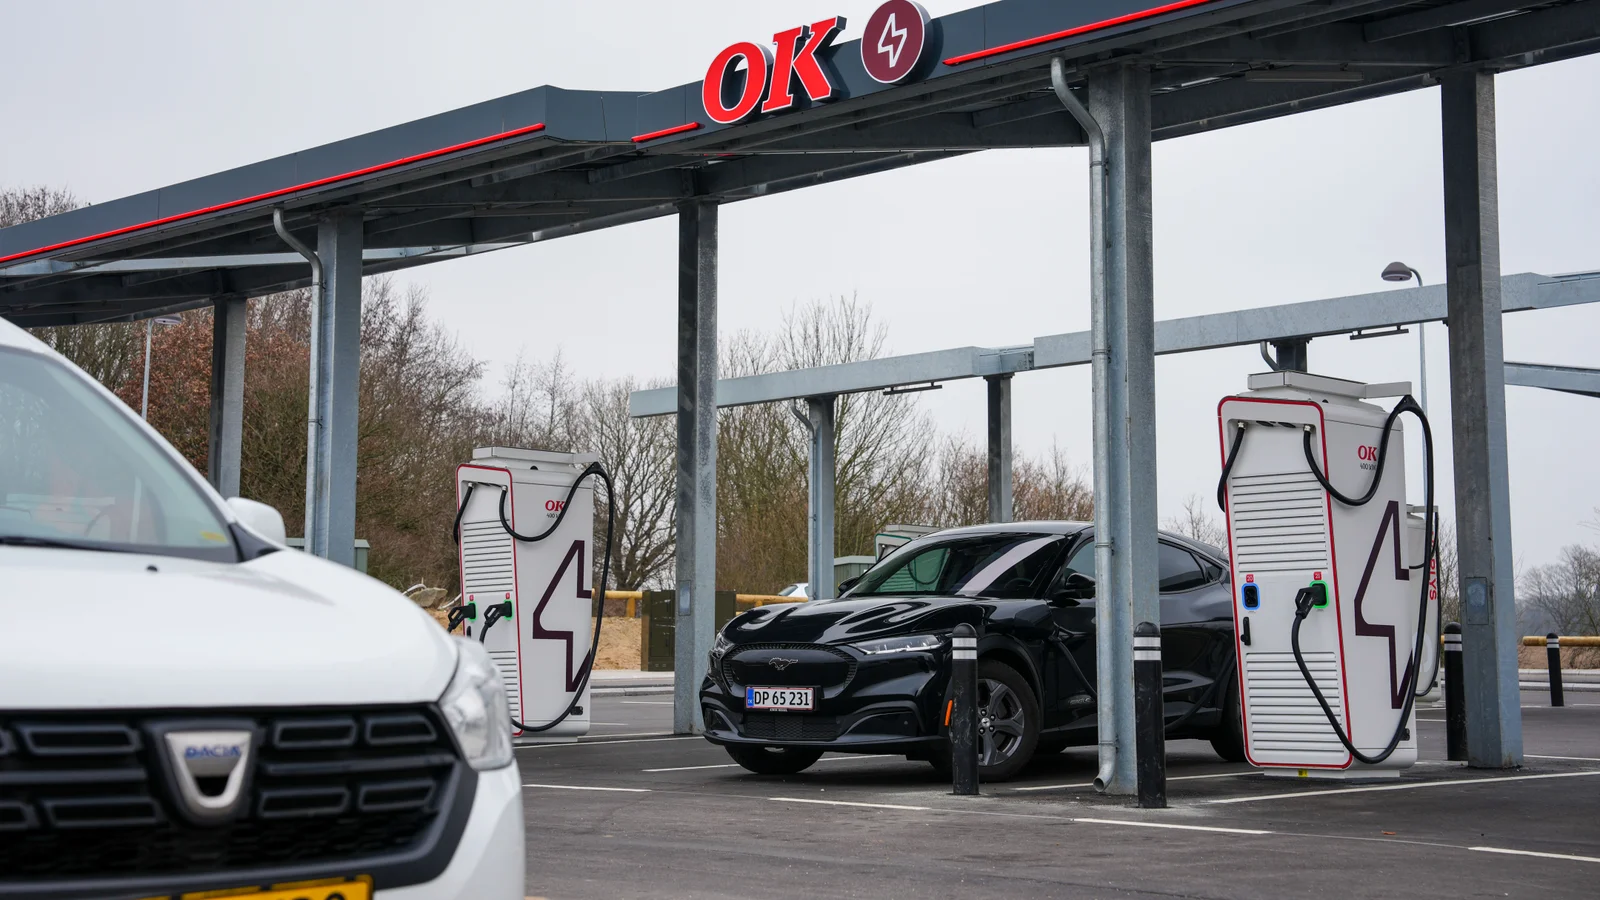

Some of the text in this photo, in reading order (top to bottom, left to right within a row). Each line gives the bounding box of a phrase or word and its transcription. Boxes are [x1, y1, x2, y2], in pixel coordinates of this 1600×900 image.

[702, 16, 839, 124] OK
[1357, 445, 1377, 461] OK
[545, 499, 565, 511] OK
[754, 691, 809, 705] DP 65 231
